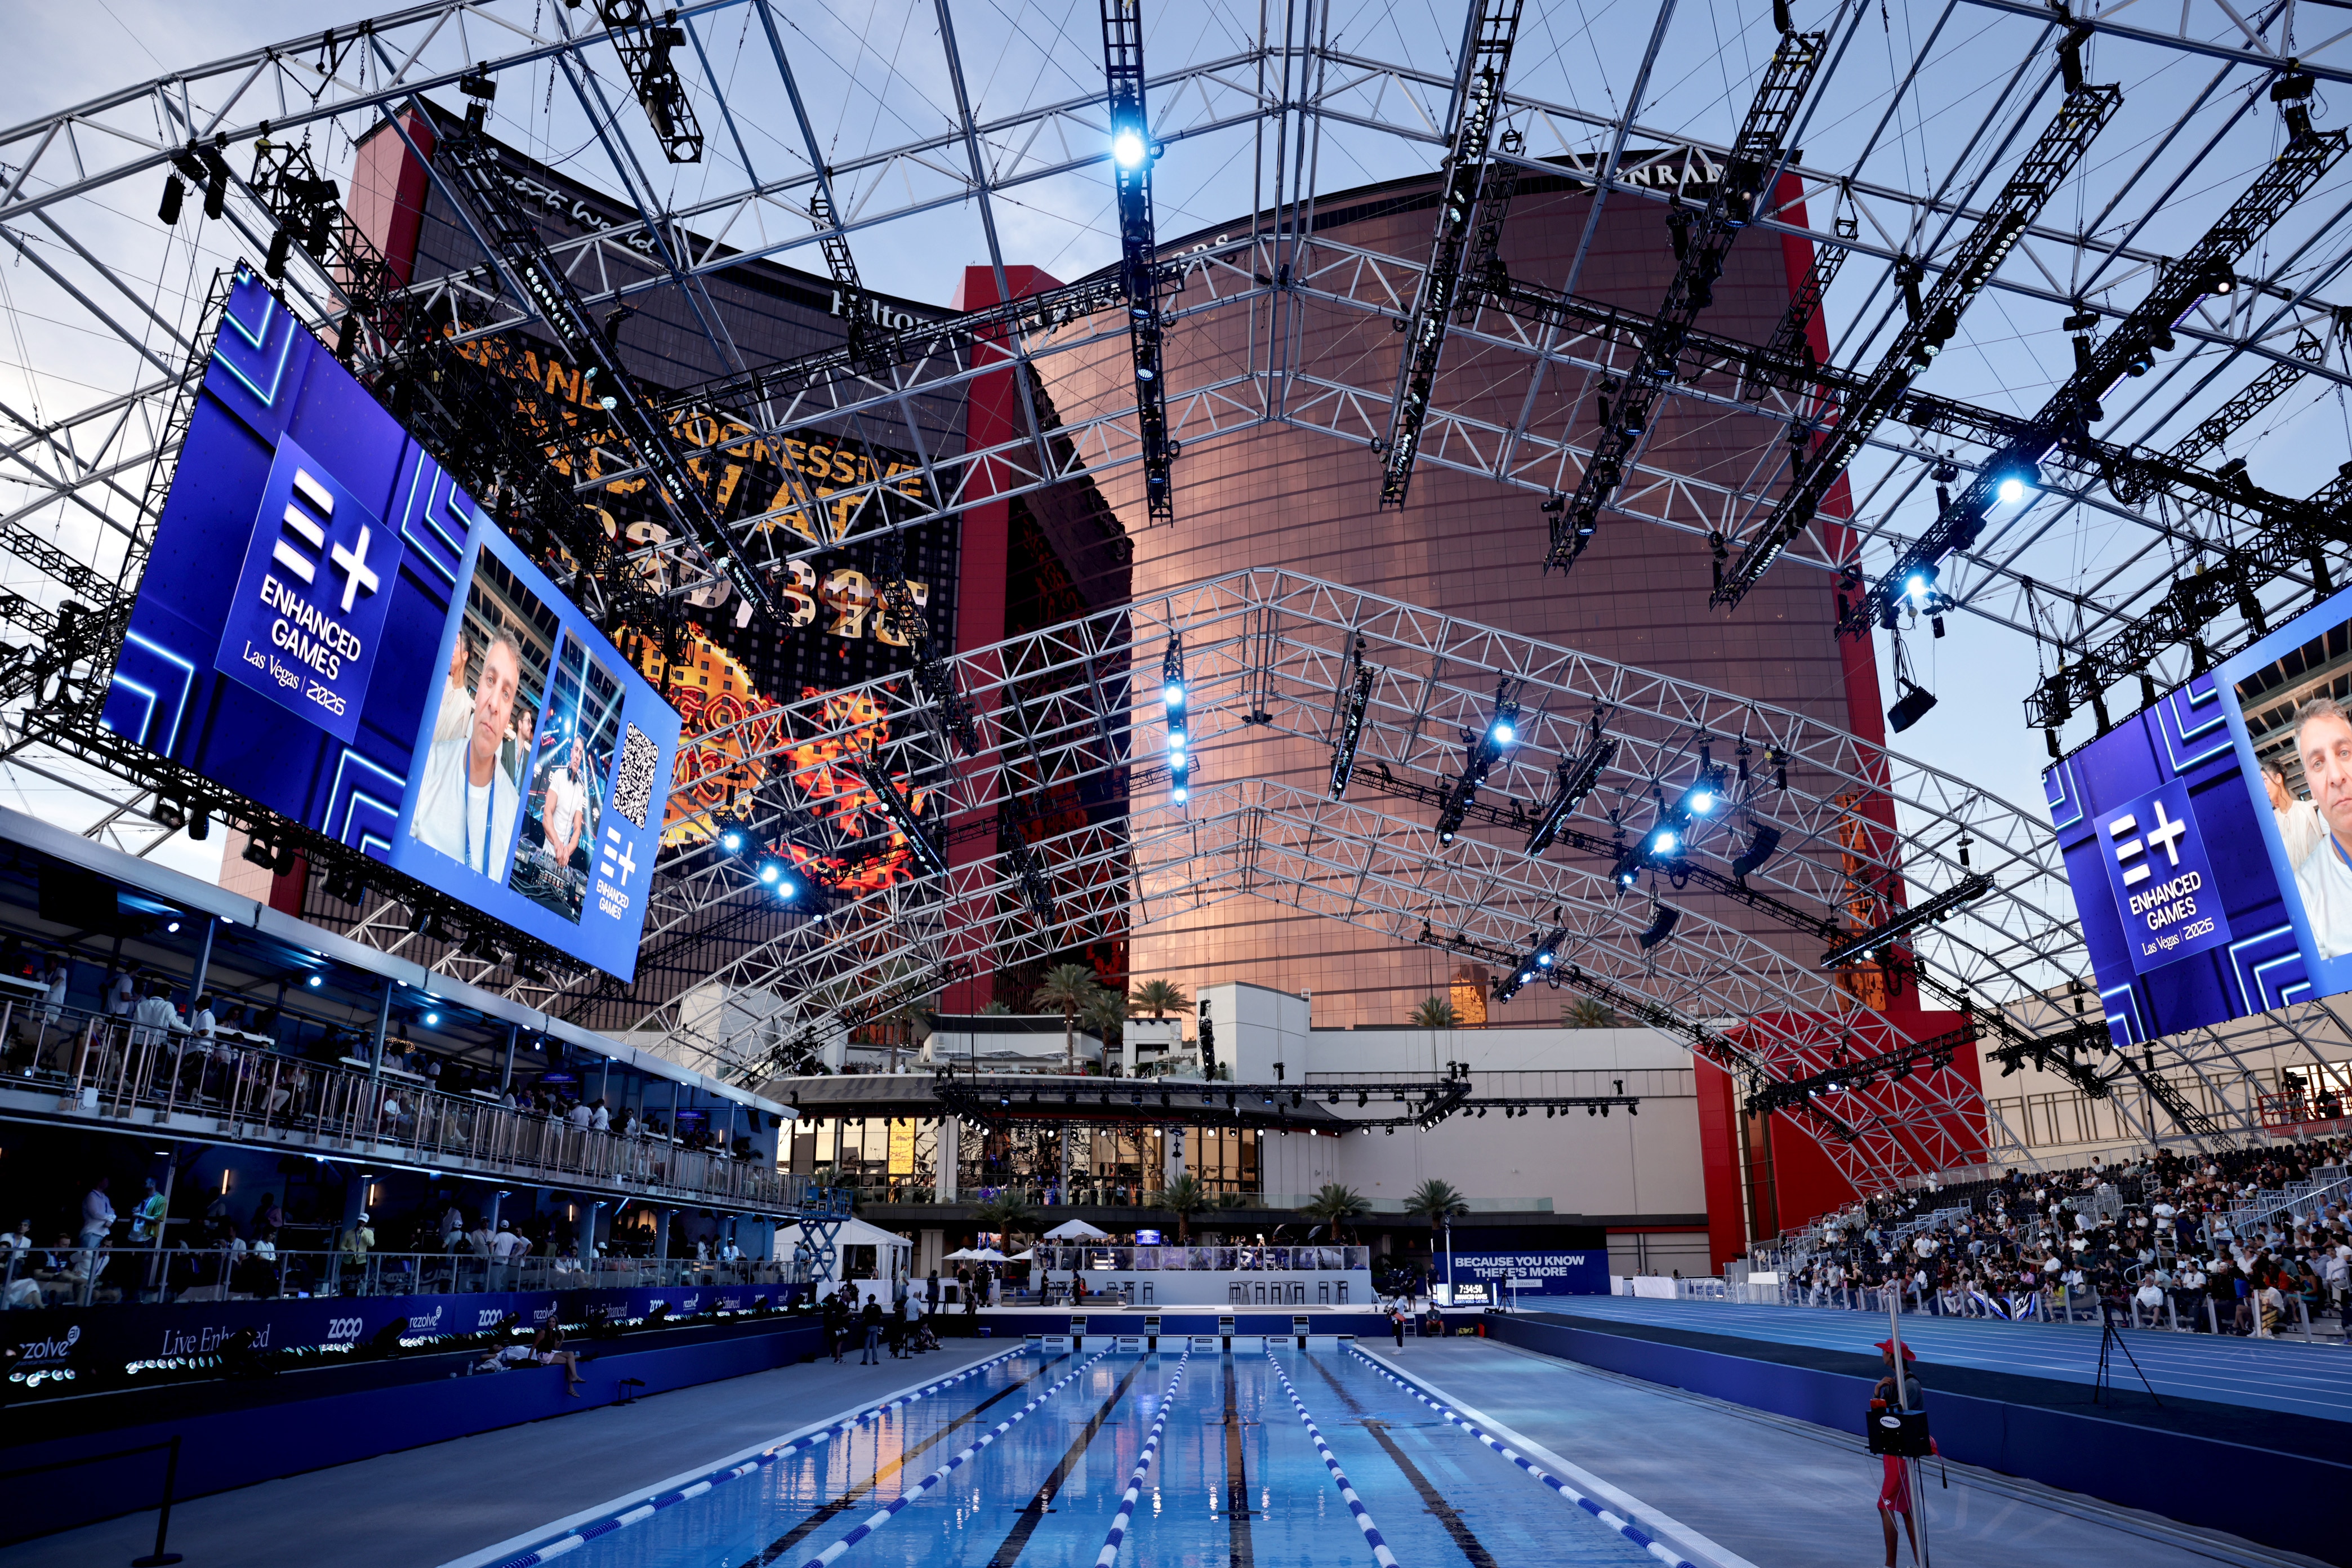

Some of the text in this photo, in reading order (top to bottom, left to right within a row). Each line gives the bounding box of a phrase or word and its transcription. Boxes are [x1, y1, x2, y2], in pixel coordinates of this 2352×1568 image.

[572, 200, 656, 254] Wold
[755, 481, 865, 550] AT
[260, 574, 361, 663] ENHANCED
[271, 620, 341, 681] GAMES
[243, 640, 346, 716] Las Vegas 2026
[596, 879, 629, 908] ENHANCED
[599, 899, 622, 920] GAMES
[2128, 870, 2202, 915] ENHANCED
[2146, 897, 2197, 931] GAMES
[2141, 917, 2215, 956] Las Vegas 2026
[1455, 1255, 1585, 1267] BECAUSE YOU KNOW
[1529, 1267, 1567, 1277] MORE
[1459, 1285, 1483, 1294] 7:34:50
[409, 1312, 437, 1329] rezolve
[161, 1330, 197, 1356] Live
